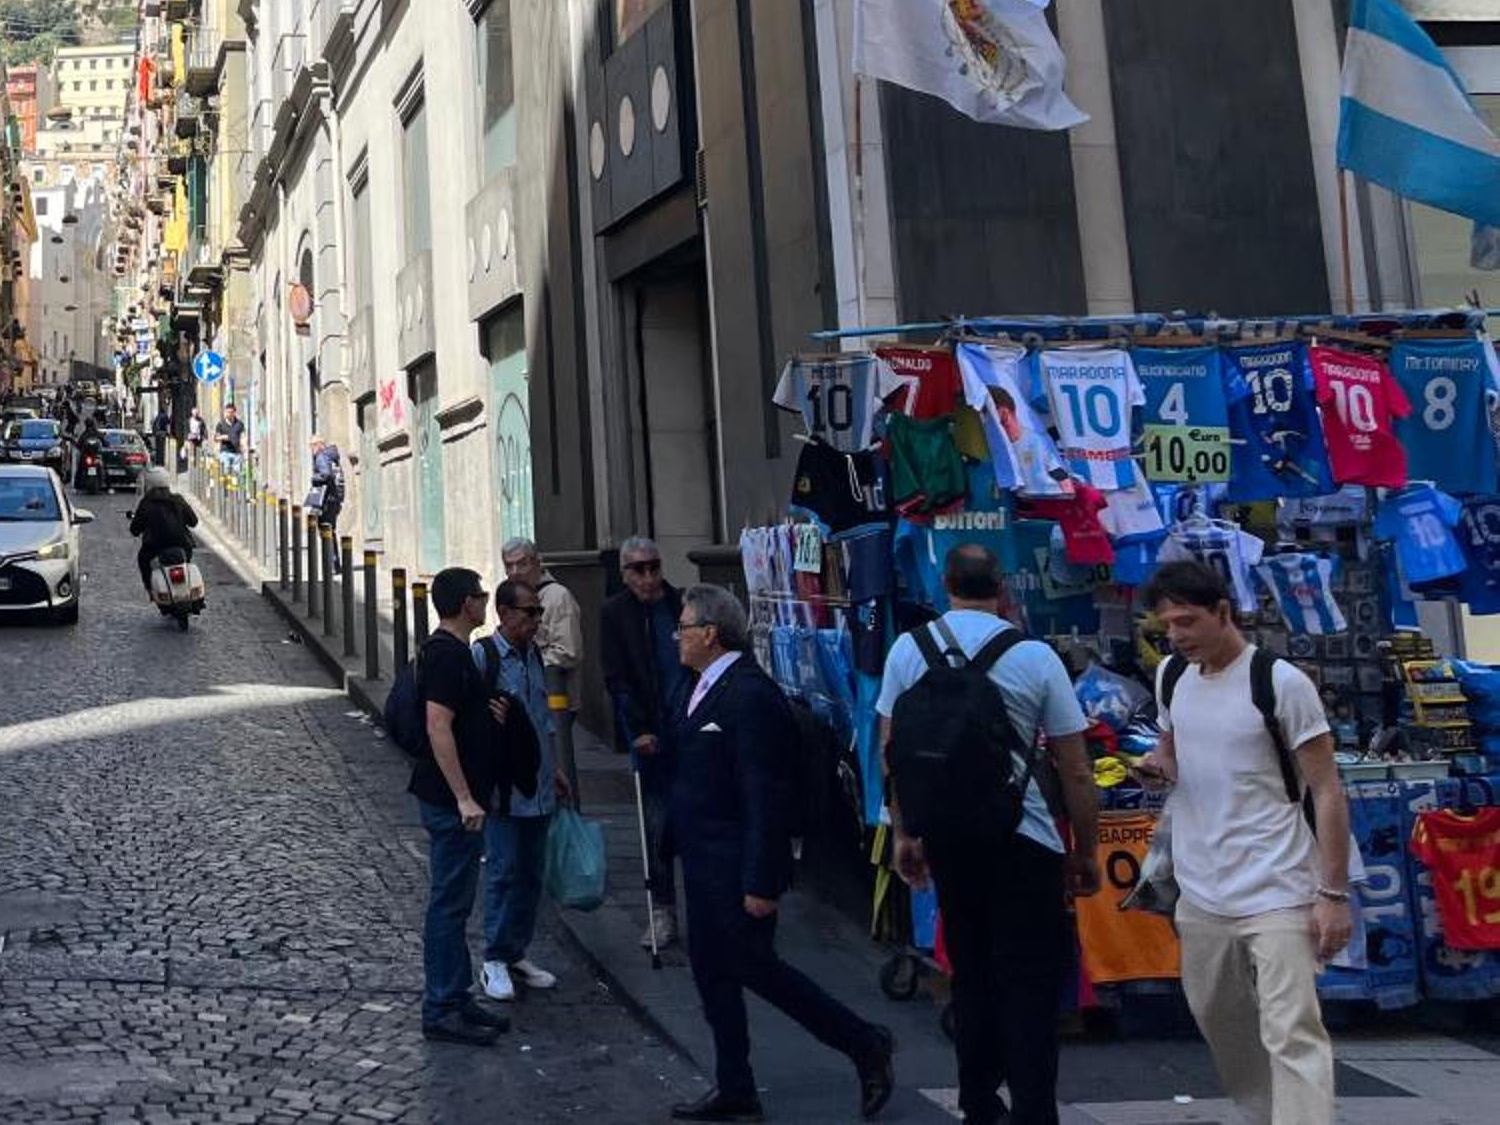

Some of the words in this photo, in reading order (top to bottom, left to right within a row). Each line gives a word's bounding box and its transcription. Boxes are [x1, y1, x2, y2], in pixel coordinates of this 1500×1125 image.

[807, 384, 852, 432] 10
[1059, 383, 1121, 438] 10
[1157, 382, 1189, 426] 4
[1246, 368, 1294, 415] 10
[1329, 379, 1378, 433] 10
[1423, 376, 1457, 431] 8
[1149, 434, 1228, 483] 10,00
